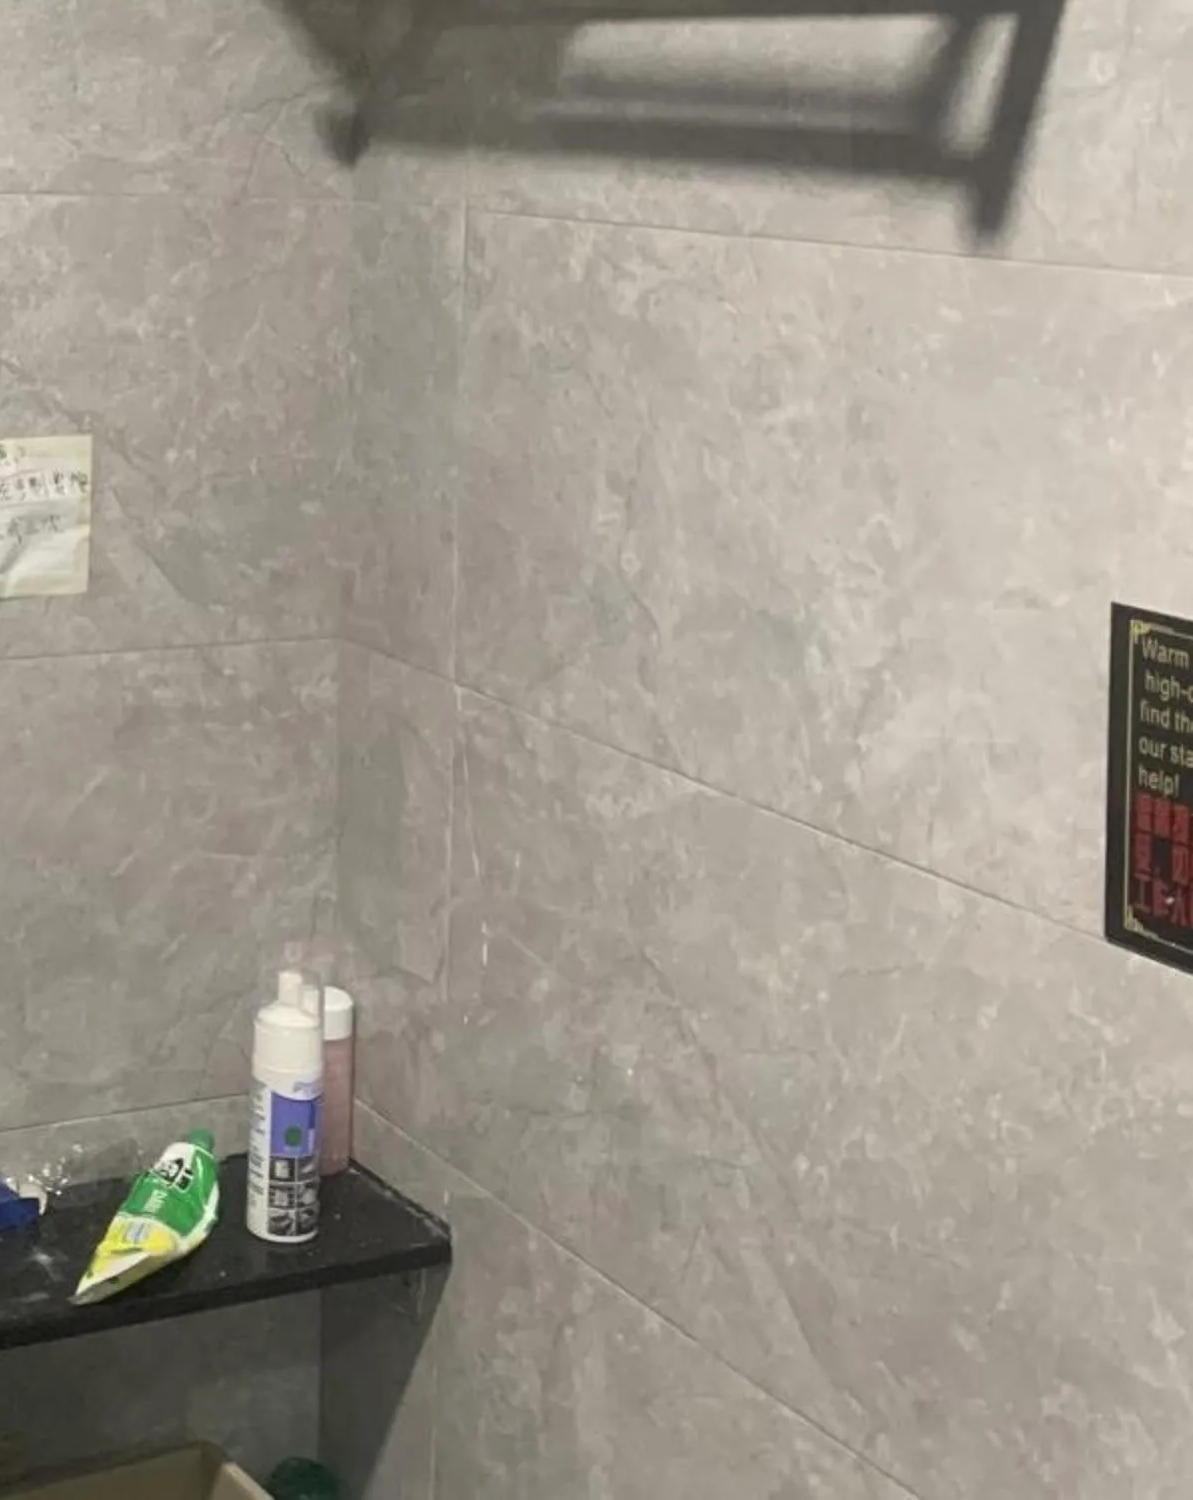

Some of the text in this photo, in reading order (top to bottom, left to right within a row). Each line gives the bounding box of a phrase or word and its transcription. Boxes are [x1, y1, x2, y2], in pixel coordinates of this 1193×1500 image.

[1142, 636, 1190, 669] Warm
[1139, 700, 1171, 730] find
[1138, 736, 1167, 762] our
[1137, 764, 1181, 798] help!
